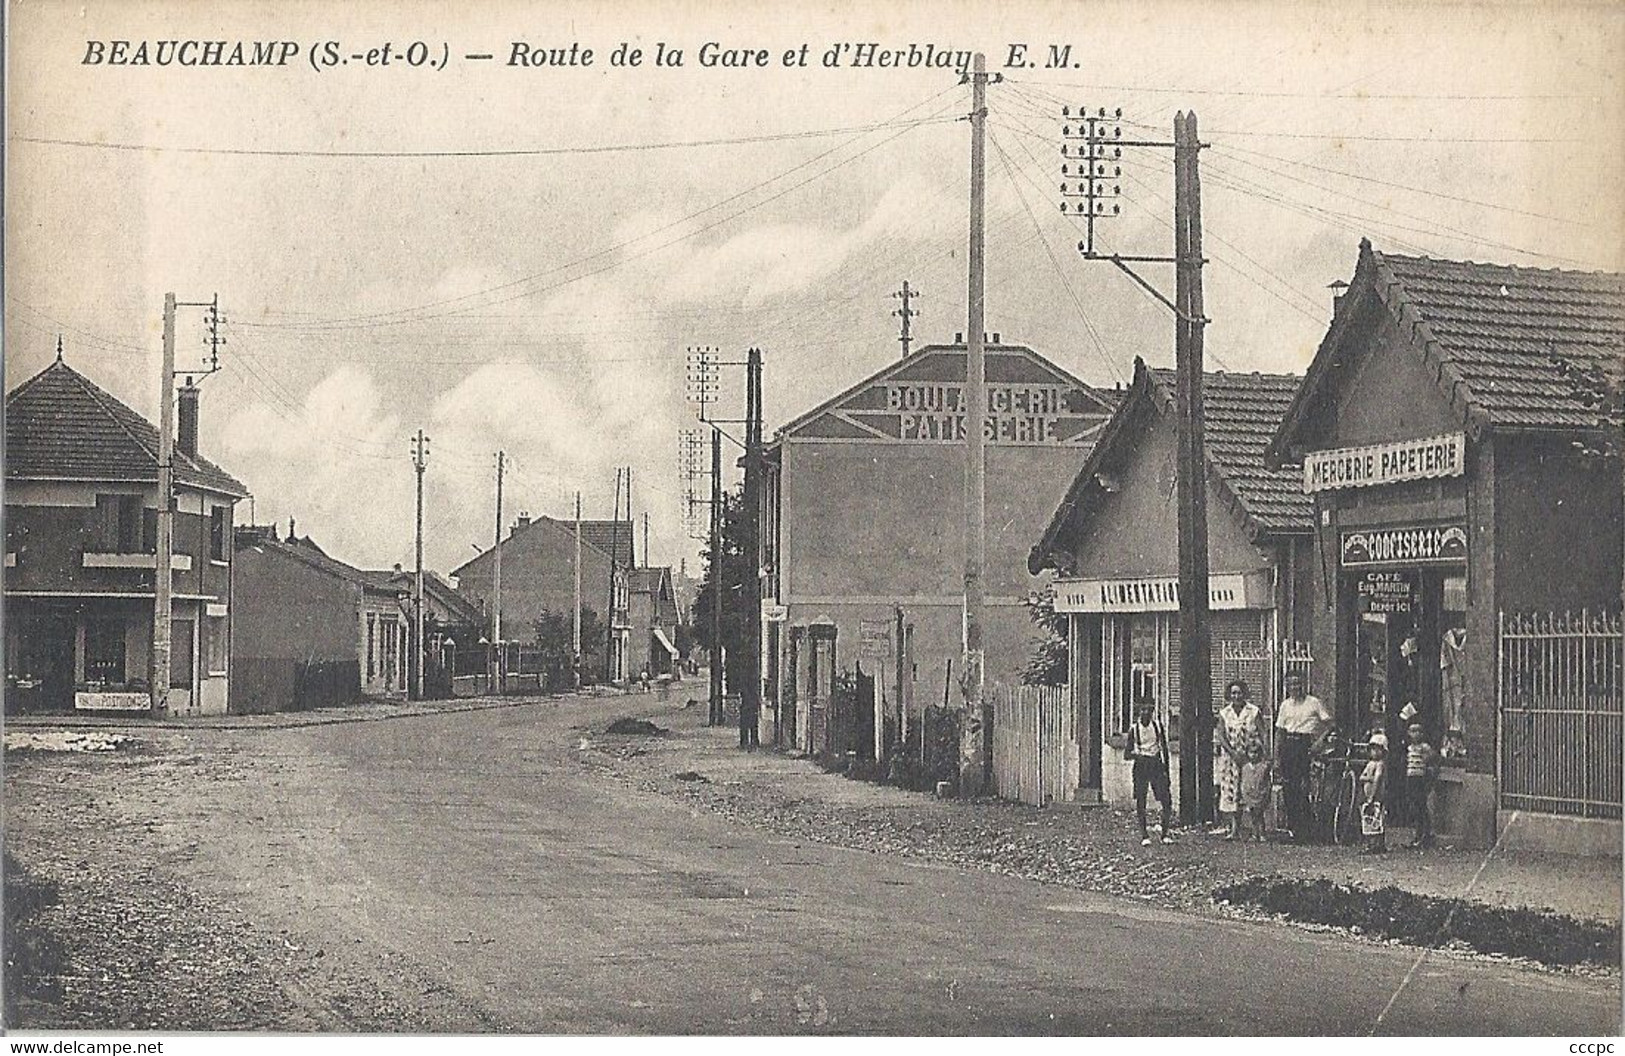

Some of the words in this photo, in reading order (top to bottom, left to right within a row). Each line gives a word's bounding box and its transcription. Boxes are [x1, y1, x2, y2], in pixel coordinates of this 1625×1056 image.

[887, 386, 1074, 414] BOULAGERIE
[1311, 455, 1374, 485] MERCERIE
[1381, 443, 1457, 476] PAPETERIE
